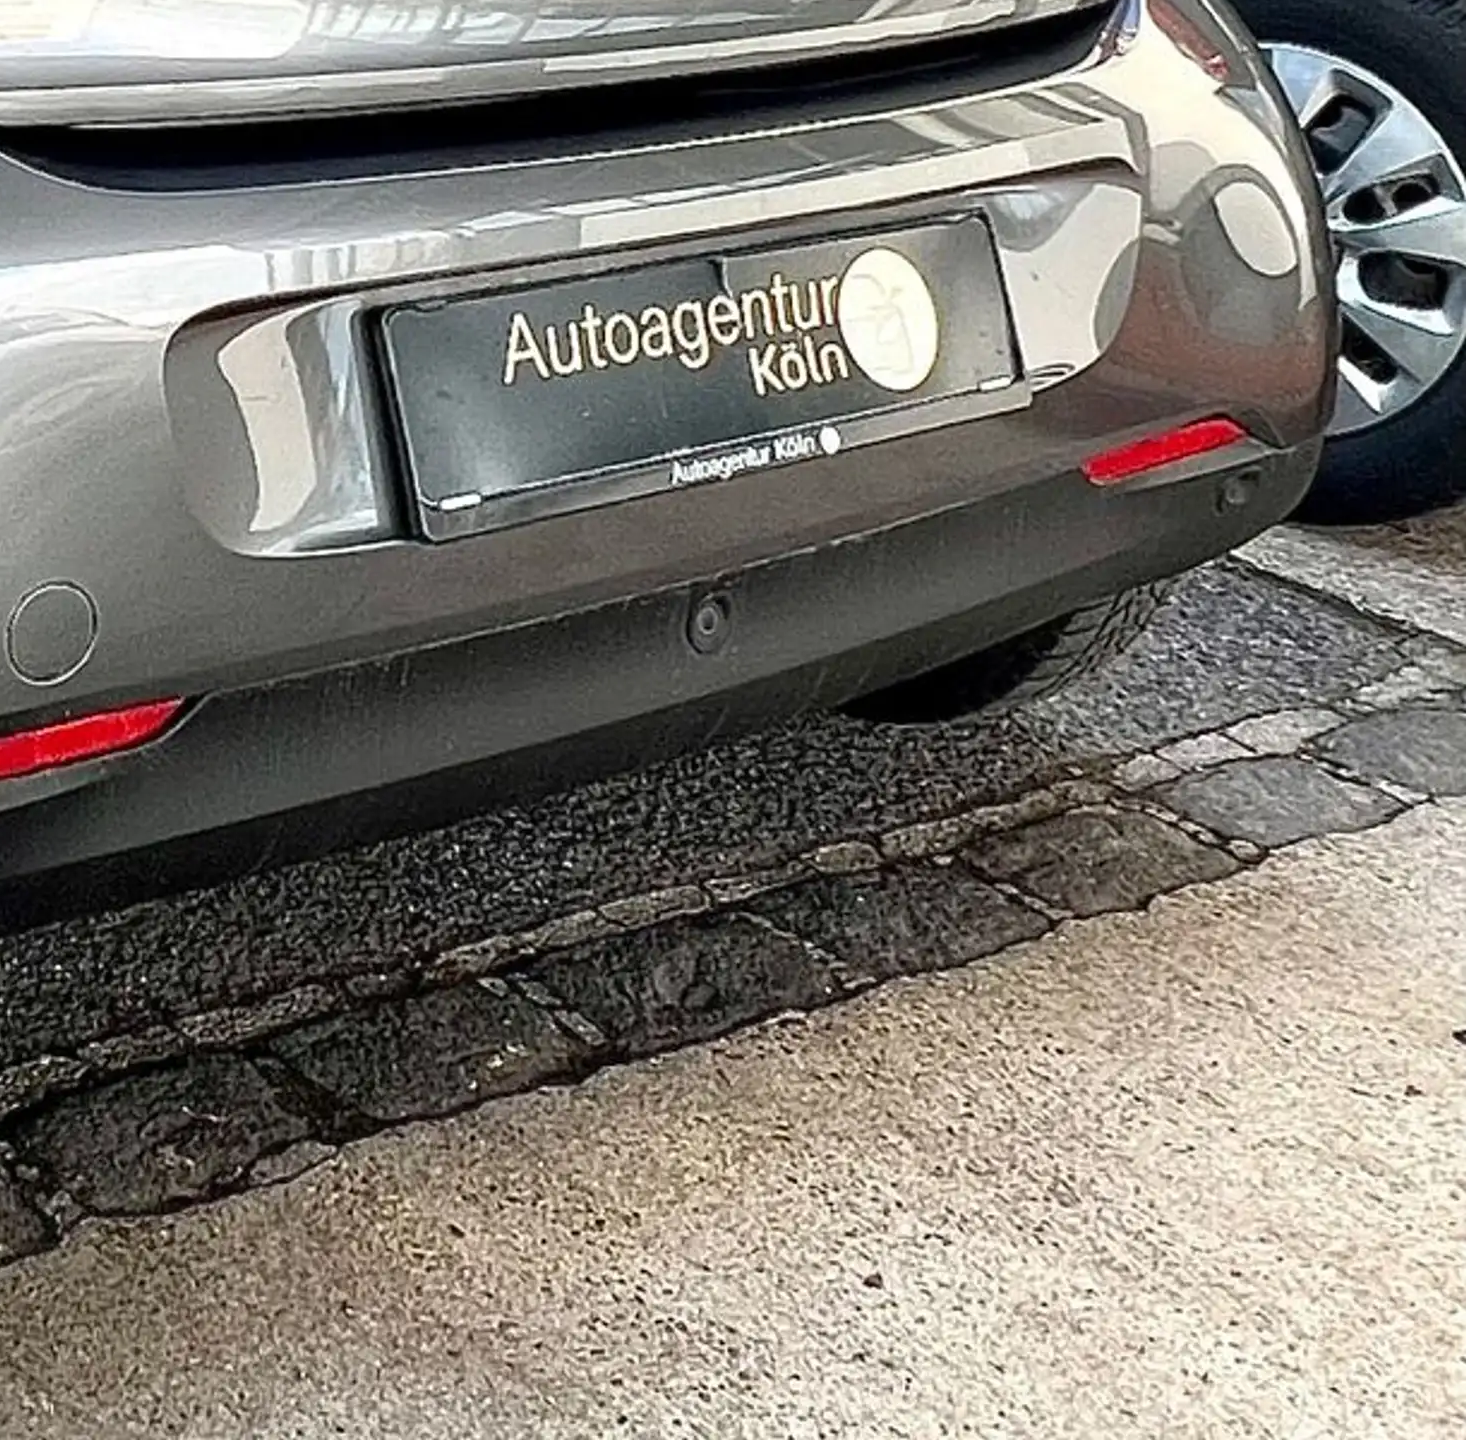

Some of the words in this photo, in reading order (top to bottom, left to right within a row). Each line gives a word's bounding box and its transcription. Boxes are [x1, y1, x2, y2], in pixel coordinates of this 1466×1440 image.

[502, 270, 840, 386] Autoagentur
[747, 334, 851, 397] Köln
[670, 444, 772, 486] Autoagentur
[772, 432, 816, 461] Köln
